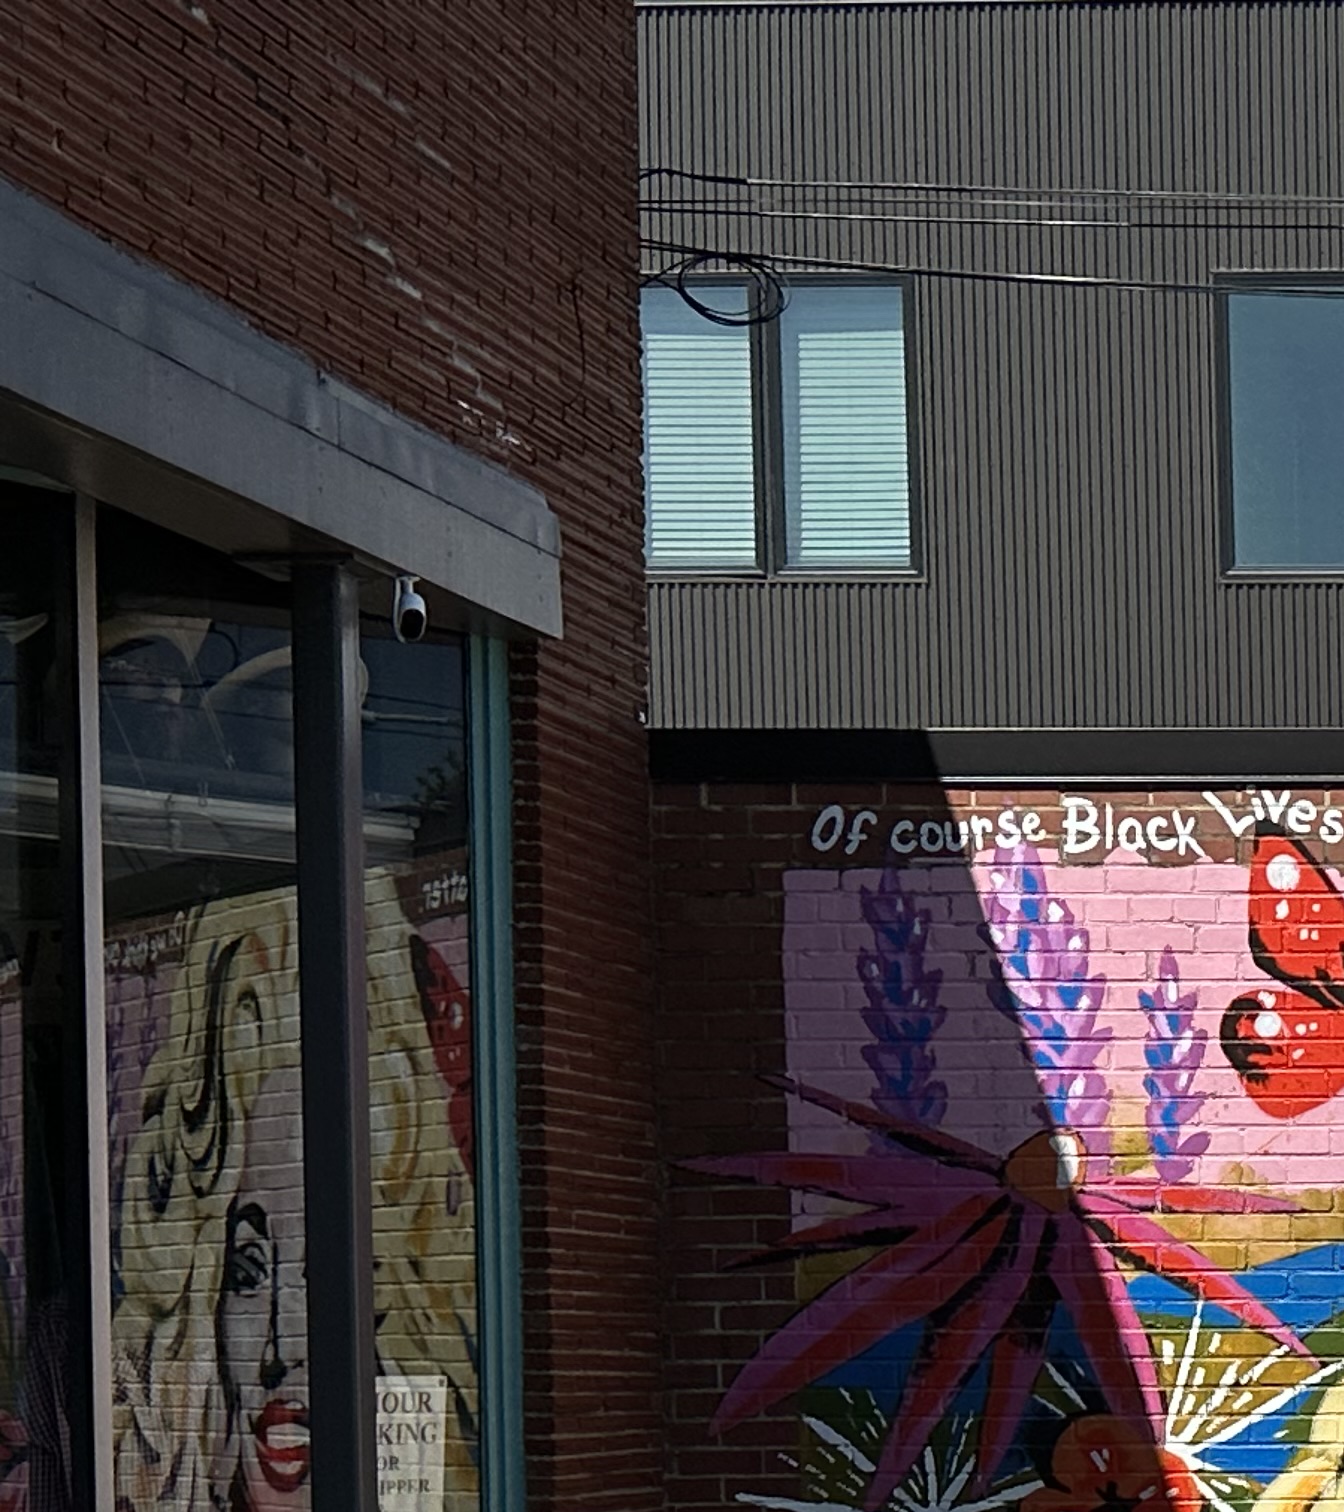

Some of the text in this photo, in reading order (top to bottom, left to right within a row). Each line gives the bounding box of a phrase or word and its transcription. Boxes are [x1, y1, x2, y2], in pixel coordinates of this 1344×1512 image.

[811, 804, 877, 853] Of
[891, 811, 1045, 852] course
[1064, 798, 1205, 856] Black
[1201, 788, 1343, 843] Lives
[377, 1391, 432, 1414] OUR
